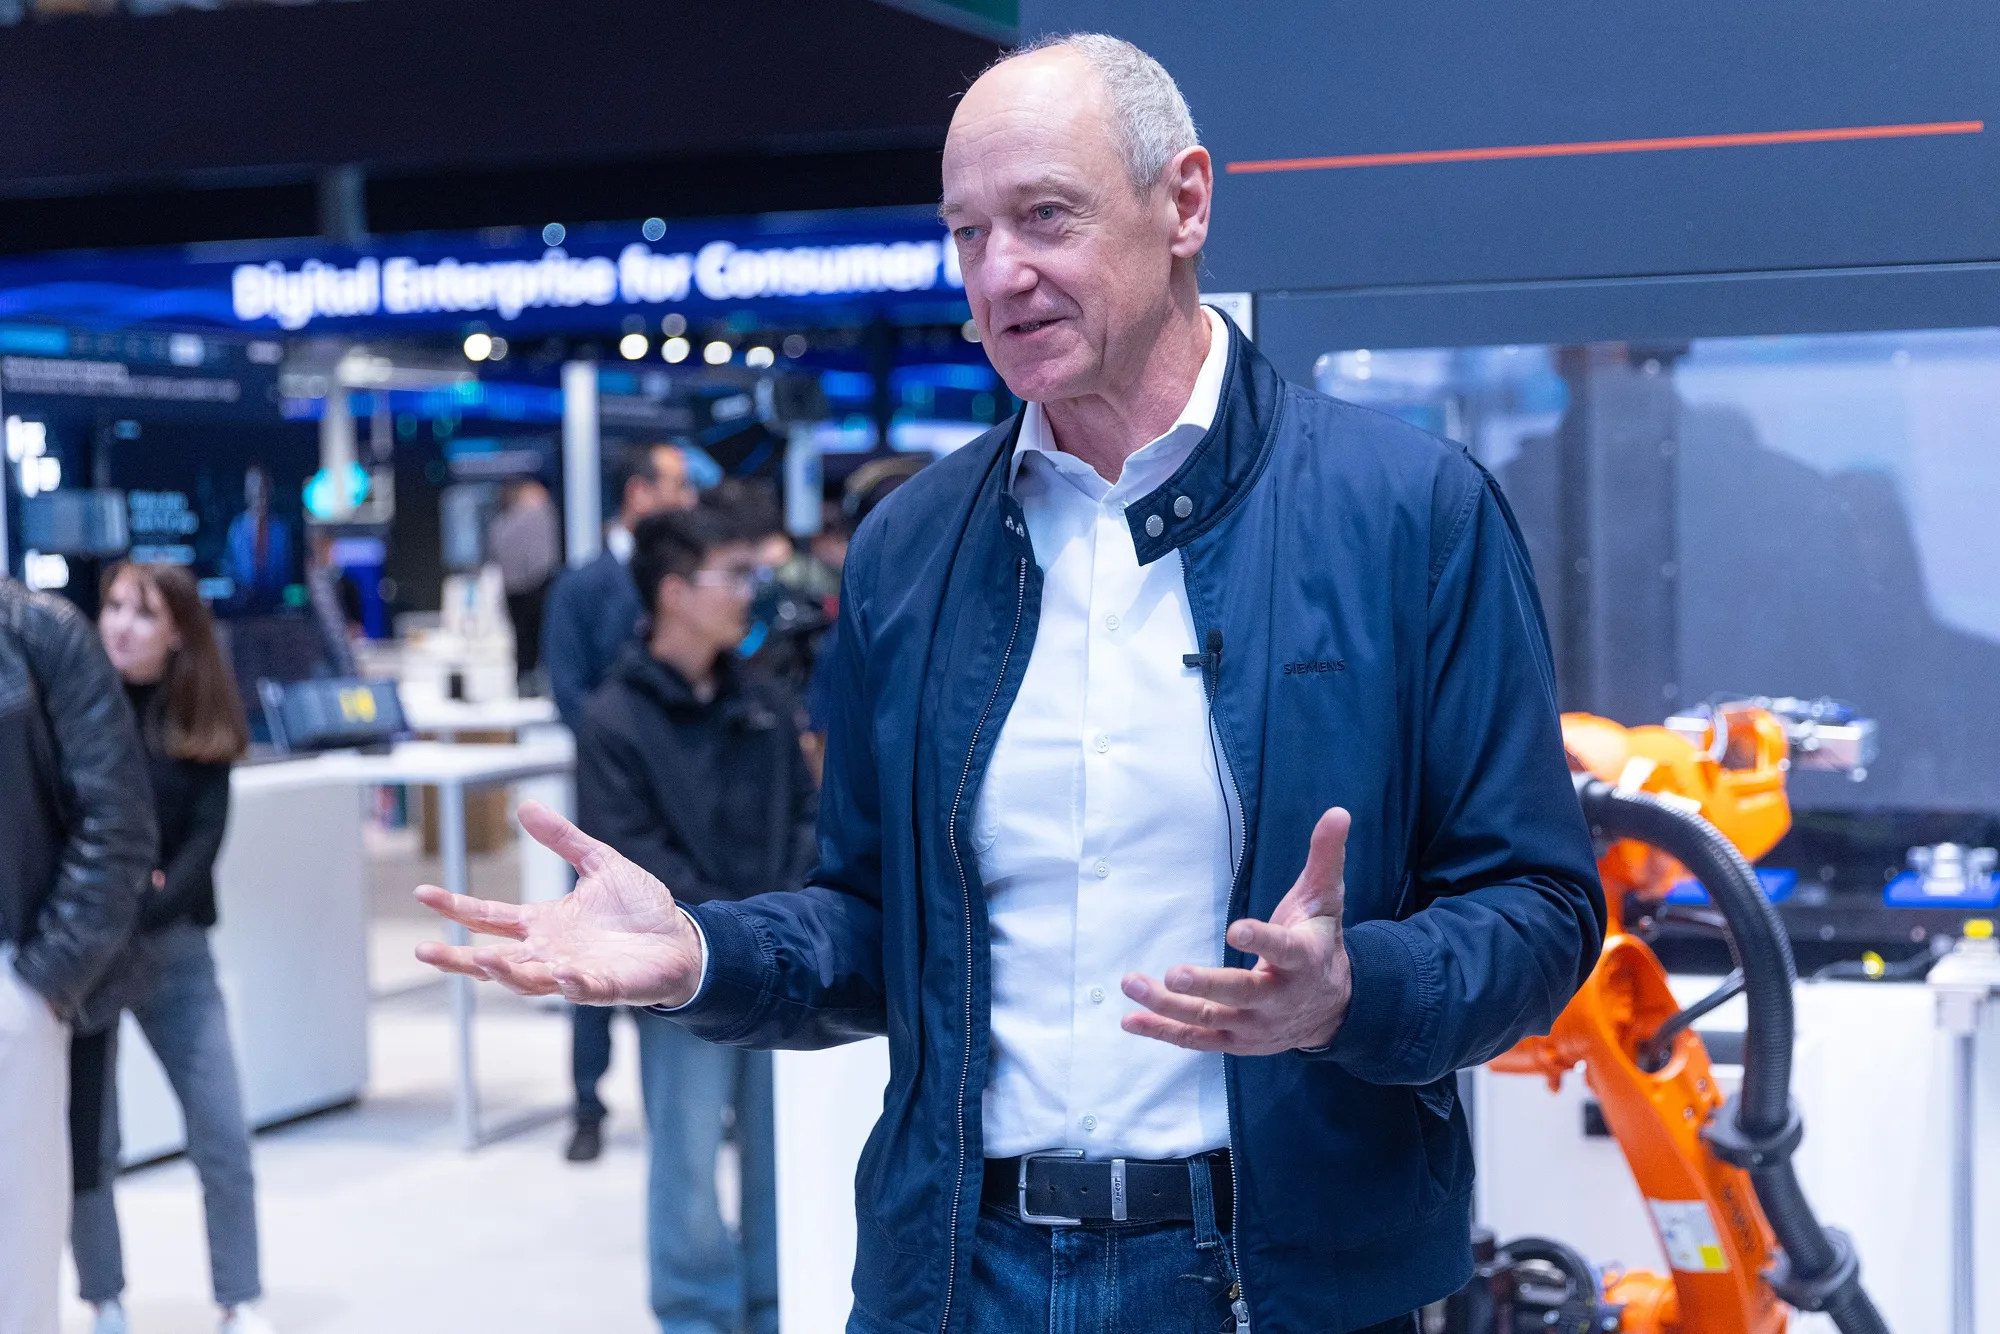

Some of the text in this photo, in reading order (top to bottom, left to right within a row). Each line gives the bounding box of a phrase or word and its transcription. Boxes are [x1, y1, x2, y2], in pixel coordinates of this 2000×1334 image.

[233, 258, 380, 329] Digital
[382, 248, 617, 321] Enterprise
[620, 242, 691, 304] for
[694, 240, 938, 300] Consumer
[1283, 660, 1346, 675] SIEMENS
